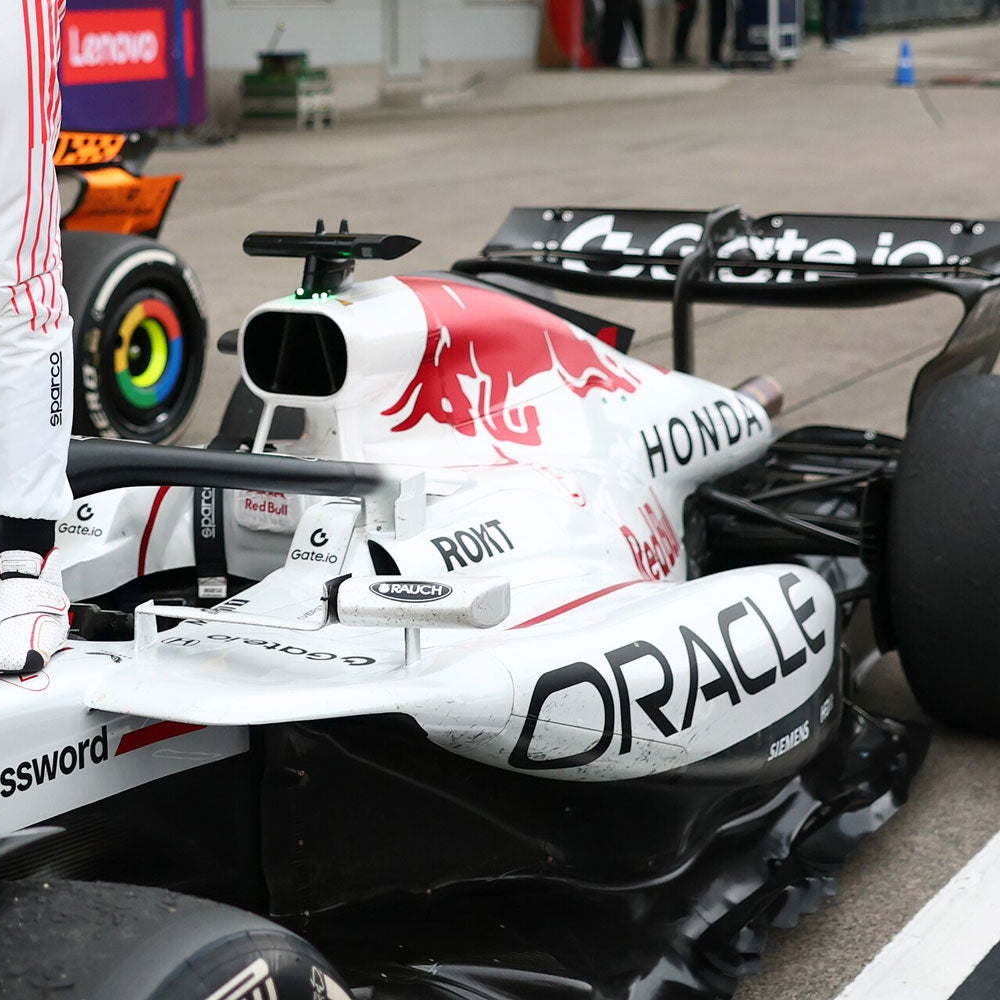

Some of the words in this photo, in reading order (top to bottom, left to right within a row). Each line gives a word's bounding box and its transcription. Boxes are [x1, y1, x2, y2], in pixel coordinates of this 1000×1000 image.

[68, 25, 159, 67] Lenovo
[50, 351, 62, 427] sparco
[640, 397, 763, 478] HONDA
[201, 487, 215, 539] sparc
[245, 498, 267, 514] Red
[267, 501, 289, 517] Bull
[58, 523, 103, 537] Gate.io
[291, 549, 338, 564] Gate.io
[390, 583, 443, 596] RAUCH
[508, 573, 826, 770] ORACLE
[767, 720, 809, 761] SIEMENS
